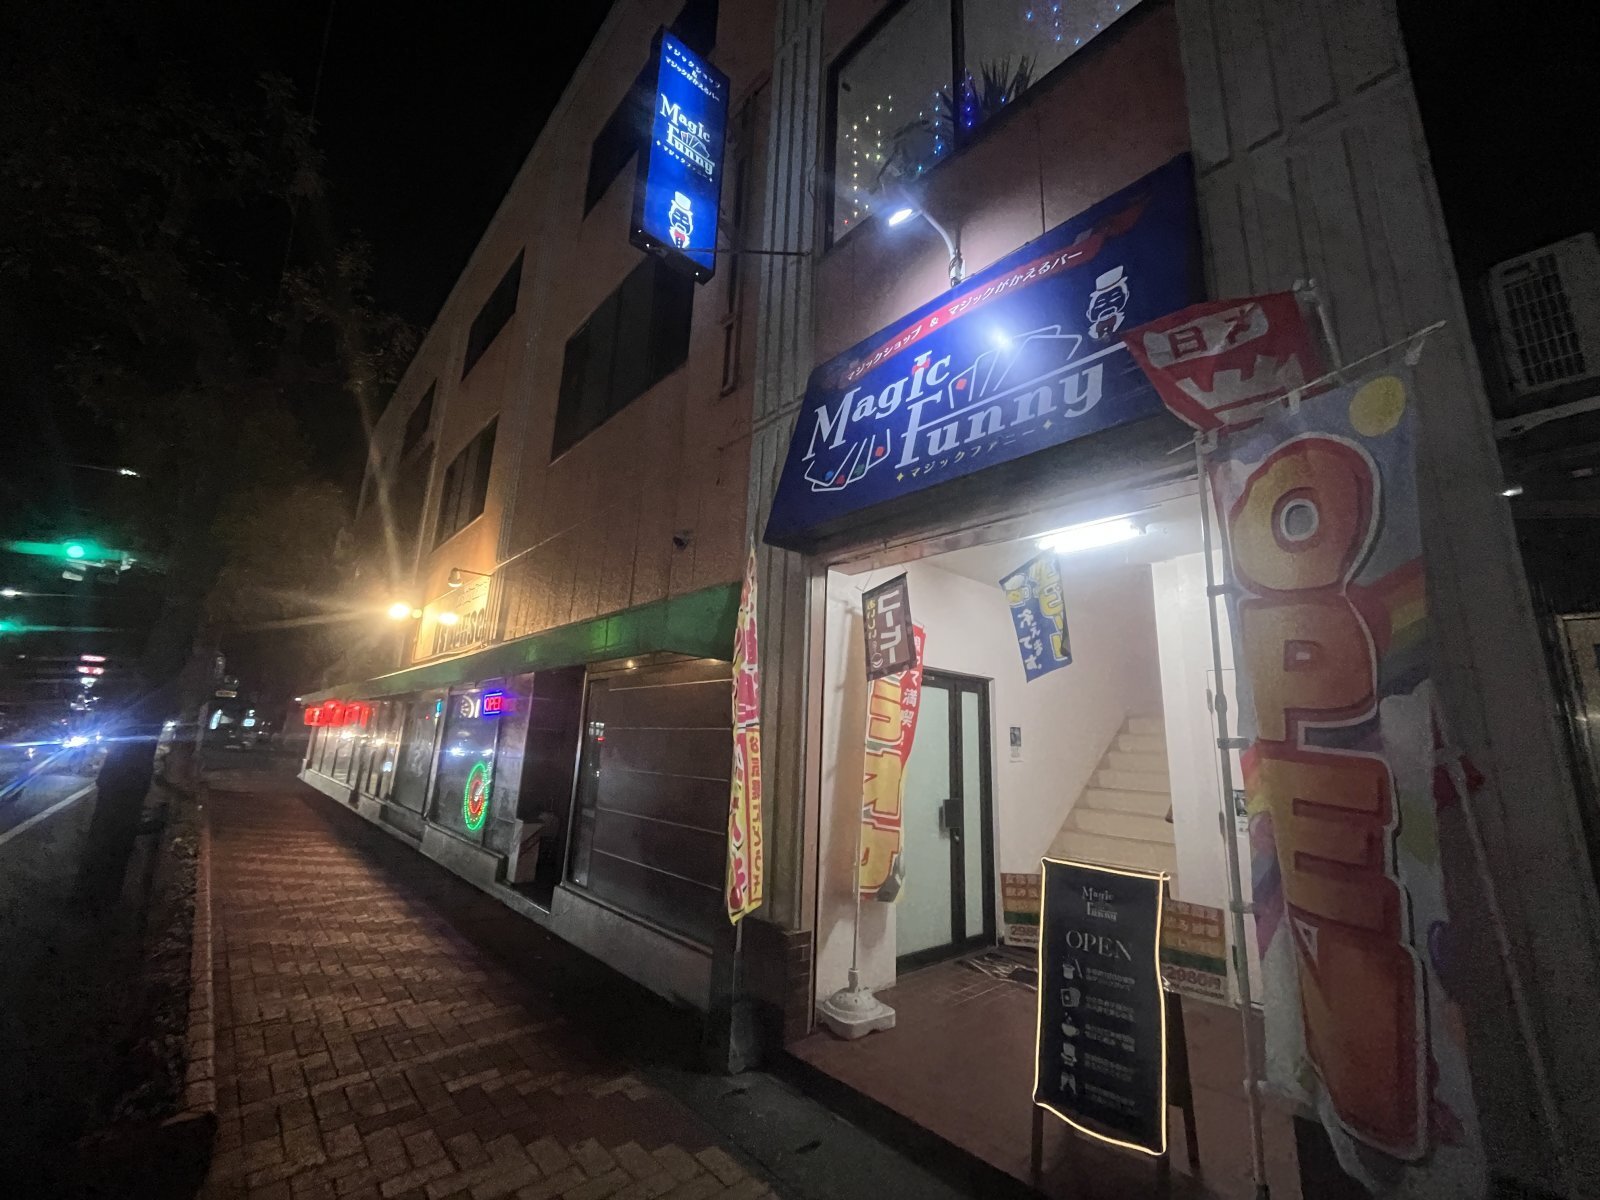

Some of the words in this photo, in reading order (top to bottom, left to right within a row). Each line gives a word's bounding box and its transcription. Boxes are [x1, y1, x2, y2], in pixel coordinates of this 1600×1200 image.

[666, 122, 716, 175] Funny
[847, 326, 923, 382] マジックショップ
[929, 316, 939, 328] &
[948, 251, 1083, 316] マジックがかえるバー
[802, 350, 951, 462] Magic
[894, 363, 1104, 470] Funny
[910, 429, 1037, 478] マジックファニー
[1066, 930, 1132, 962] OPEN
